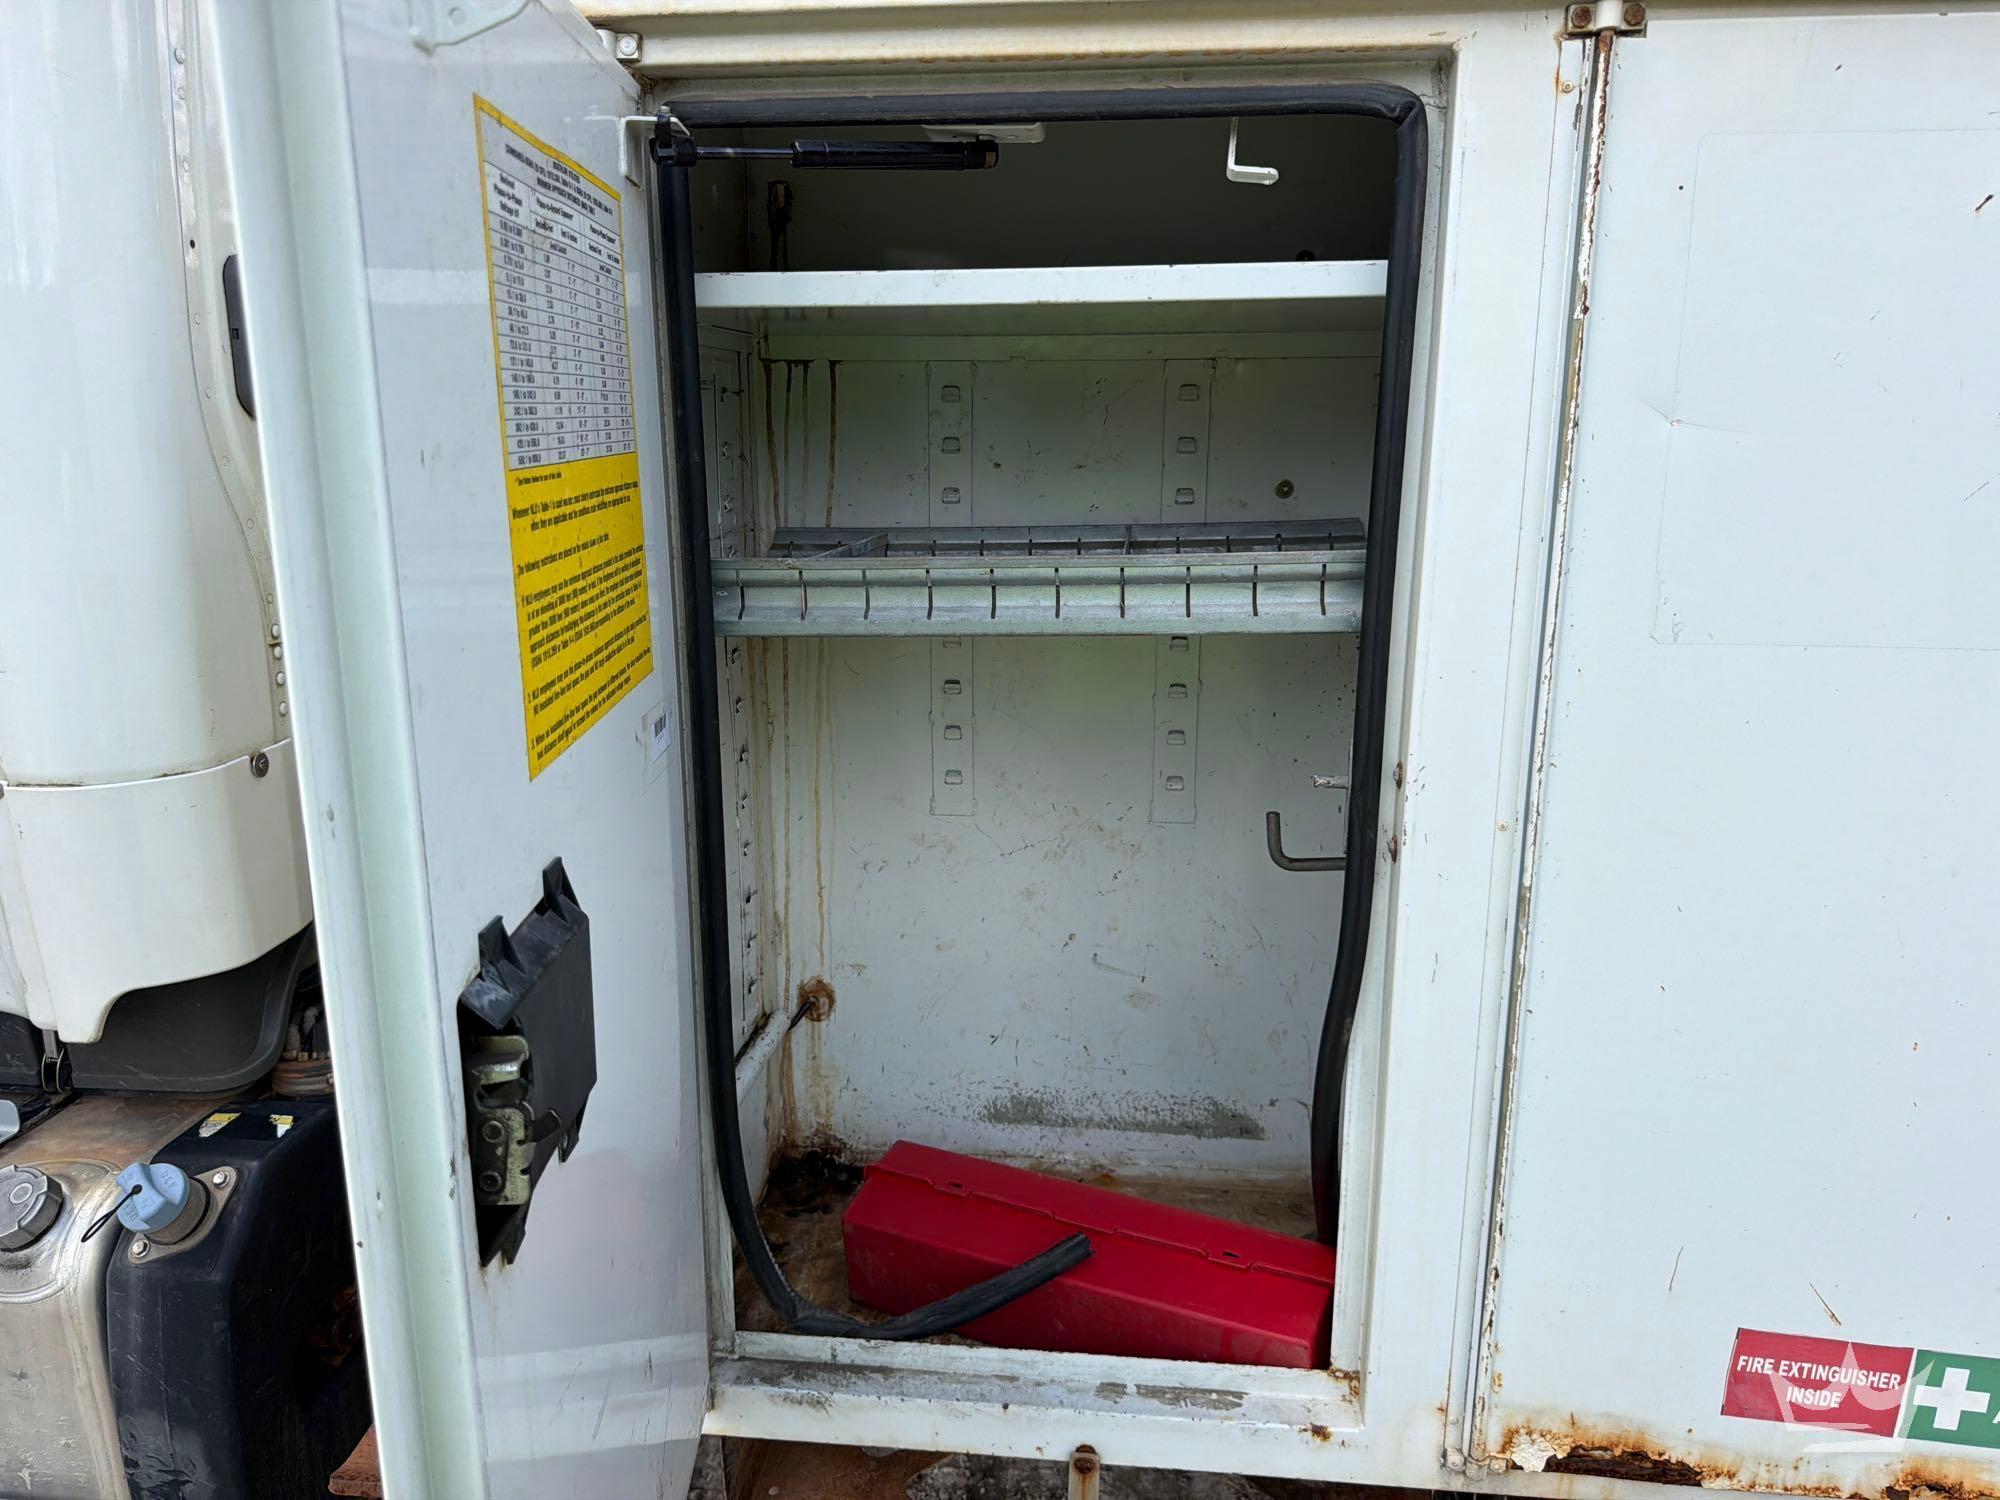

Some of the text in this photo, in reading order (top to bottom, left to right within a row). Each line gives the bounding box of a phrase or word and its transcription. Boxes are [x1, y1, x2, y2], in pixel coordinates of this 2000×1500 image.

[1736, 1355, 1901, 1391] FIRE EXTINGUISHER
[1786, 1386, 1842, 1408] INSIDE
